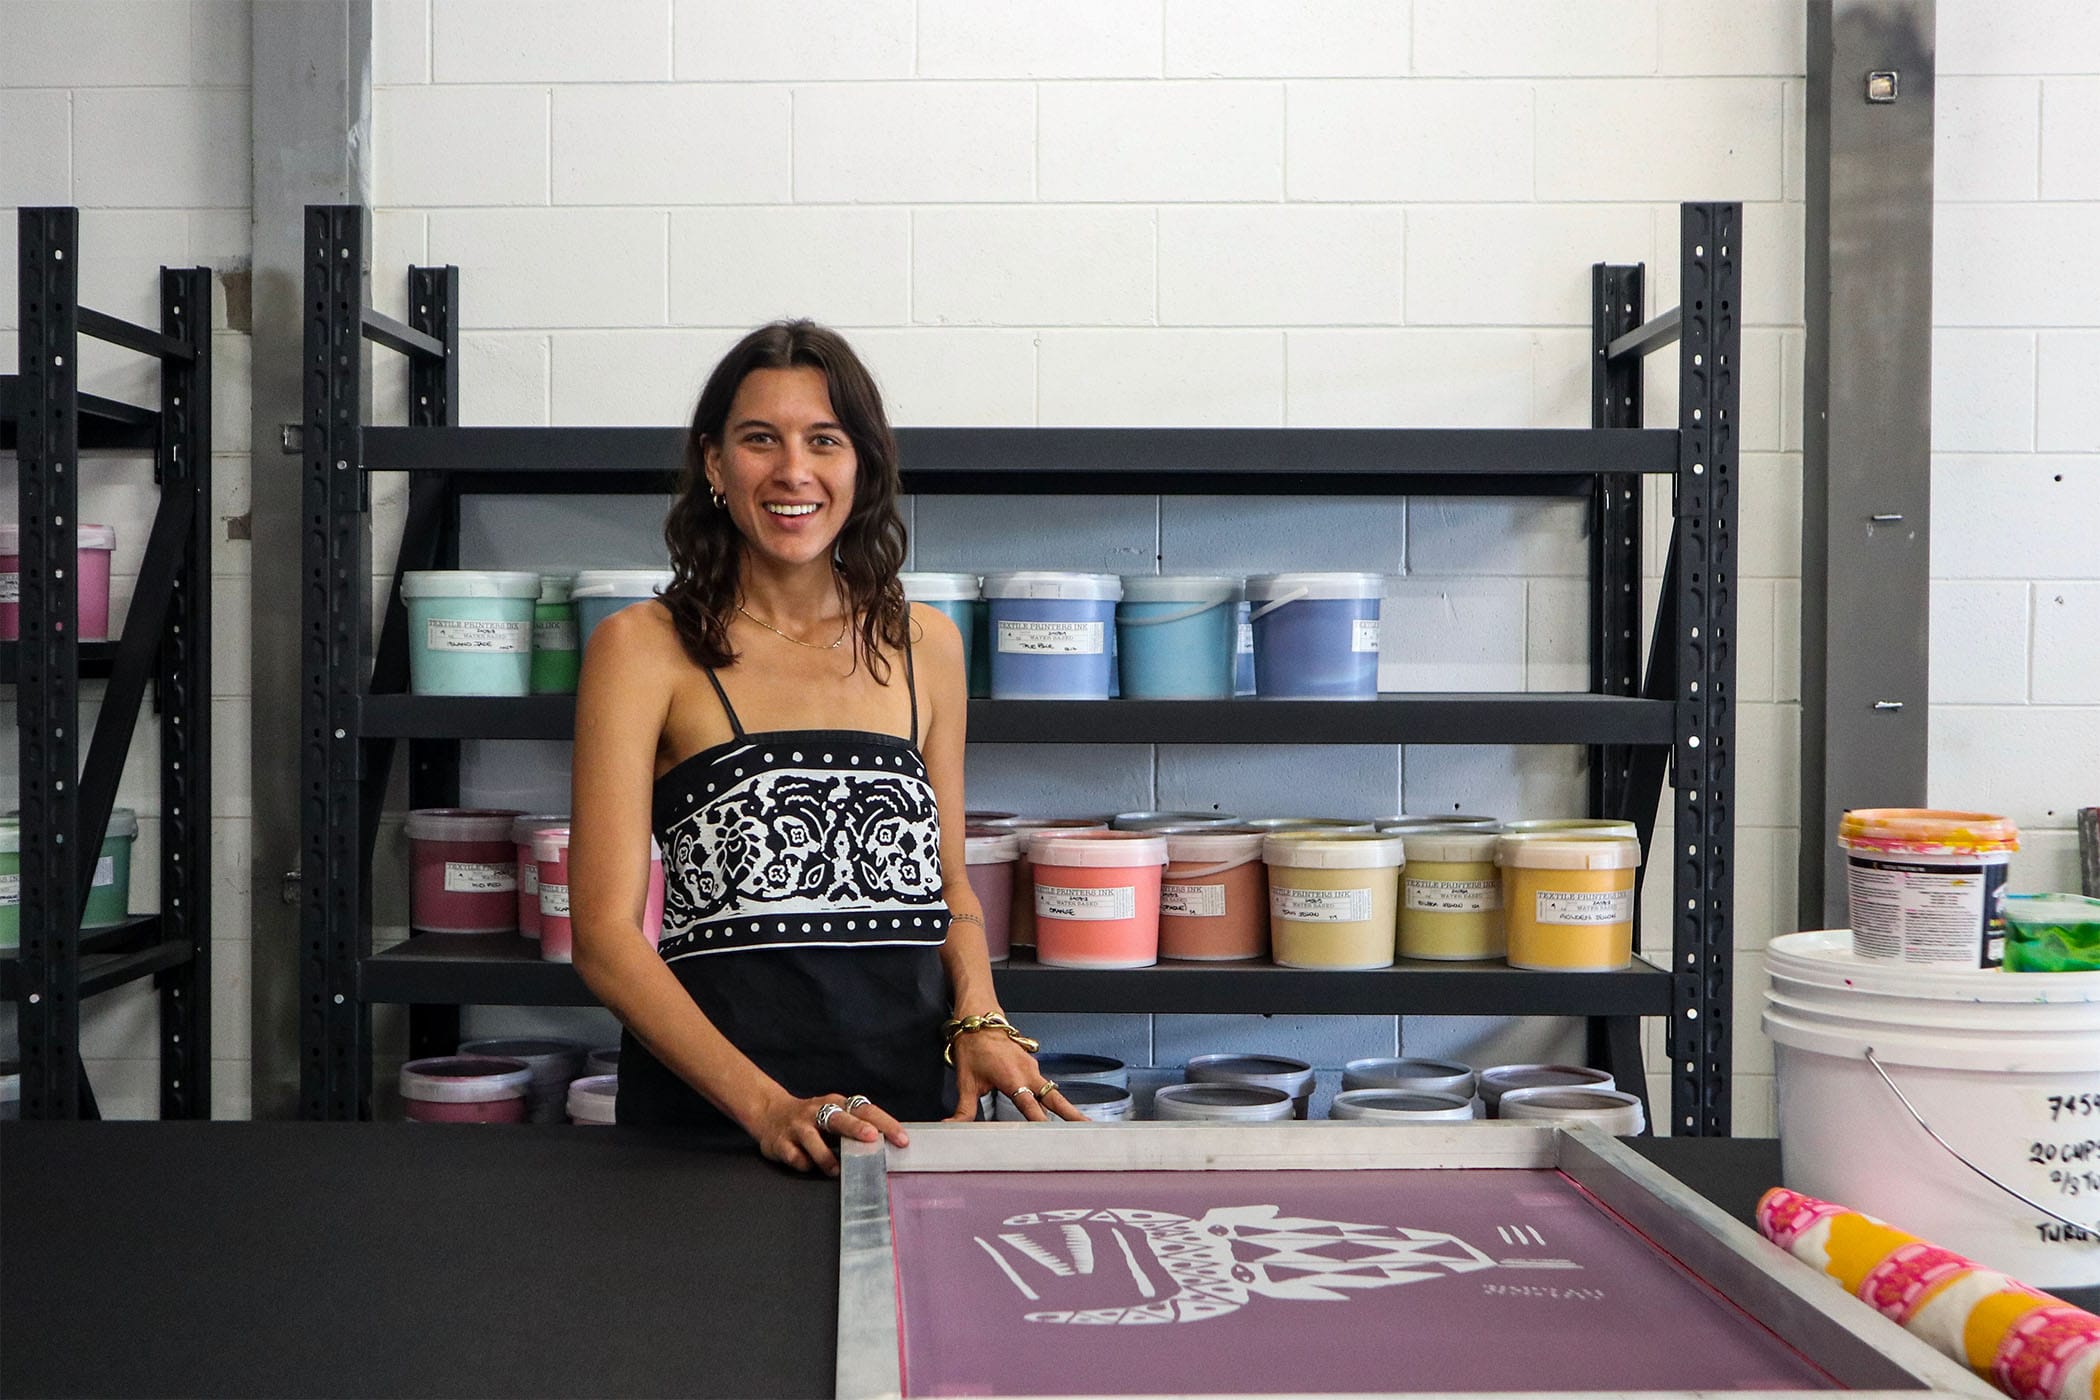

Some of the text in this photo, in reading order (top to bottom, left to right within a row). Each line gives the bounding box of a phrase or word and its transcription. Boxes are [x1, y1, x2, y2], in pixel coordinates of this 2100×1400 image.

[429, 619, 519, 630] TEXTILE PRINTERS INK
[1000, 622, 1088, 631] TEXTILE PRINTERS INK
[1407, 880, 1438, 888] TEXTILE
[1441, 881, 1480, 889] PRINTERS
[1056, 888, 1096, 897] PRINTERS
[1098, 888, 1114, 896] INK
[1292, 890, 1332, 898] PRINTERS
[1335, 890, 1350, 898] INK
[1538, 891, 1575, 900] TEXTILE
[1577, 892, 1616, 901] PRINTERS
